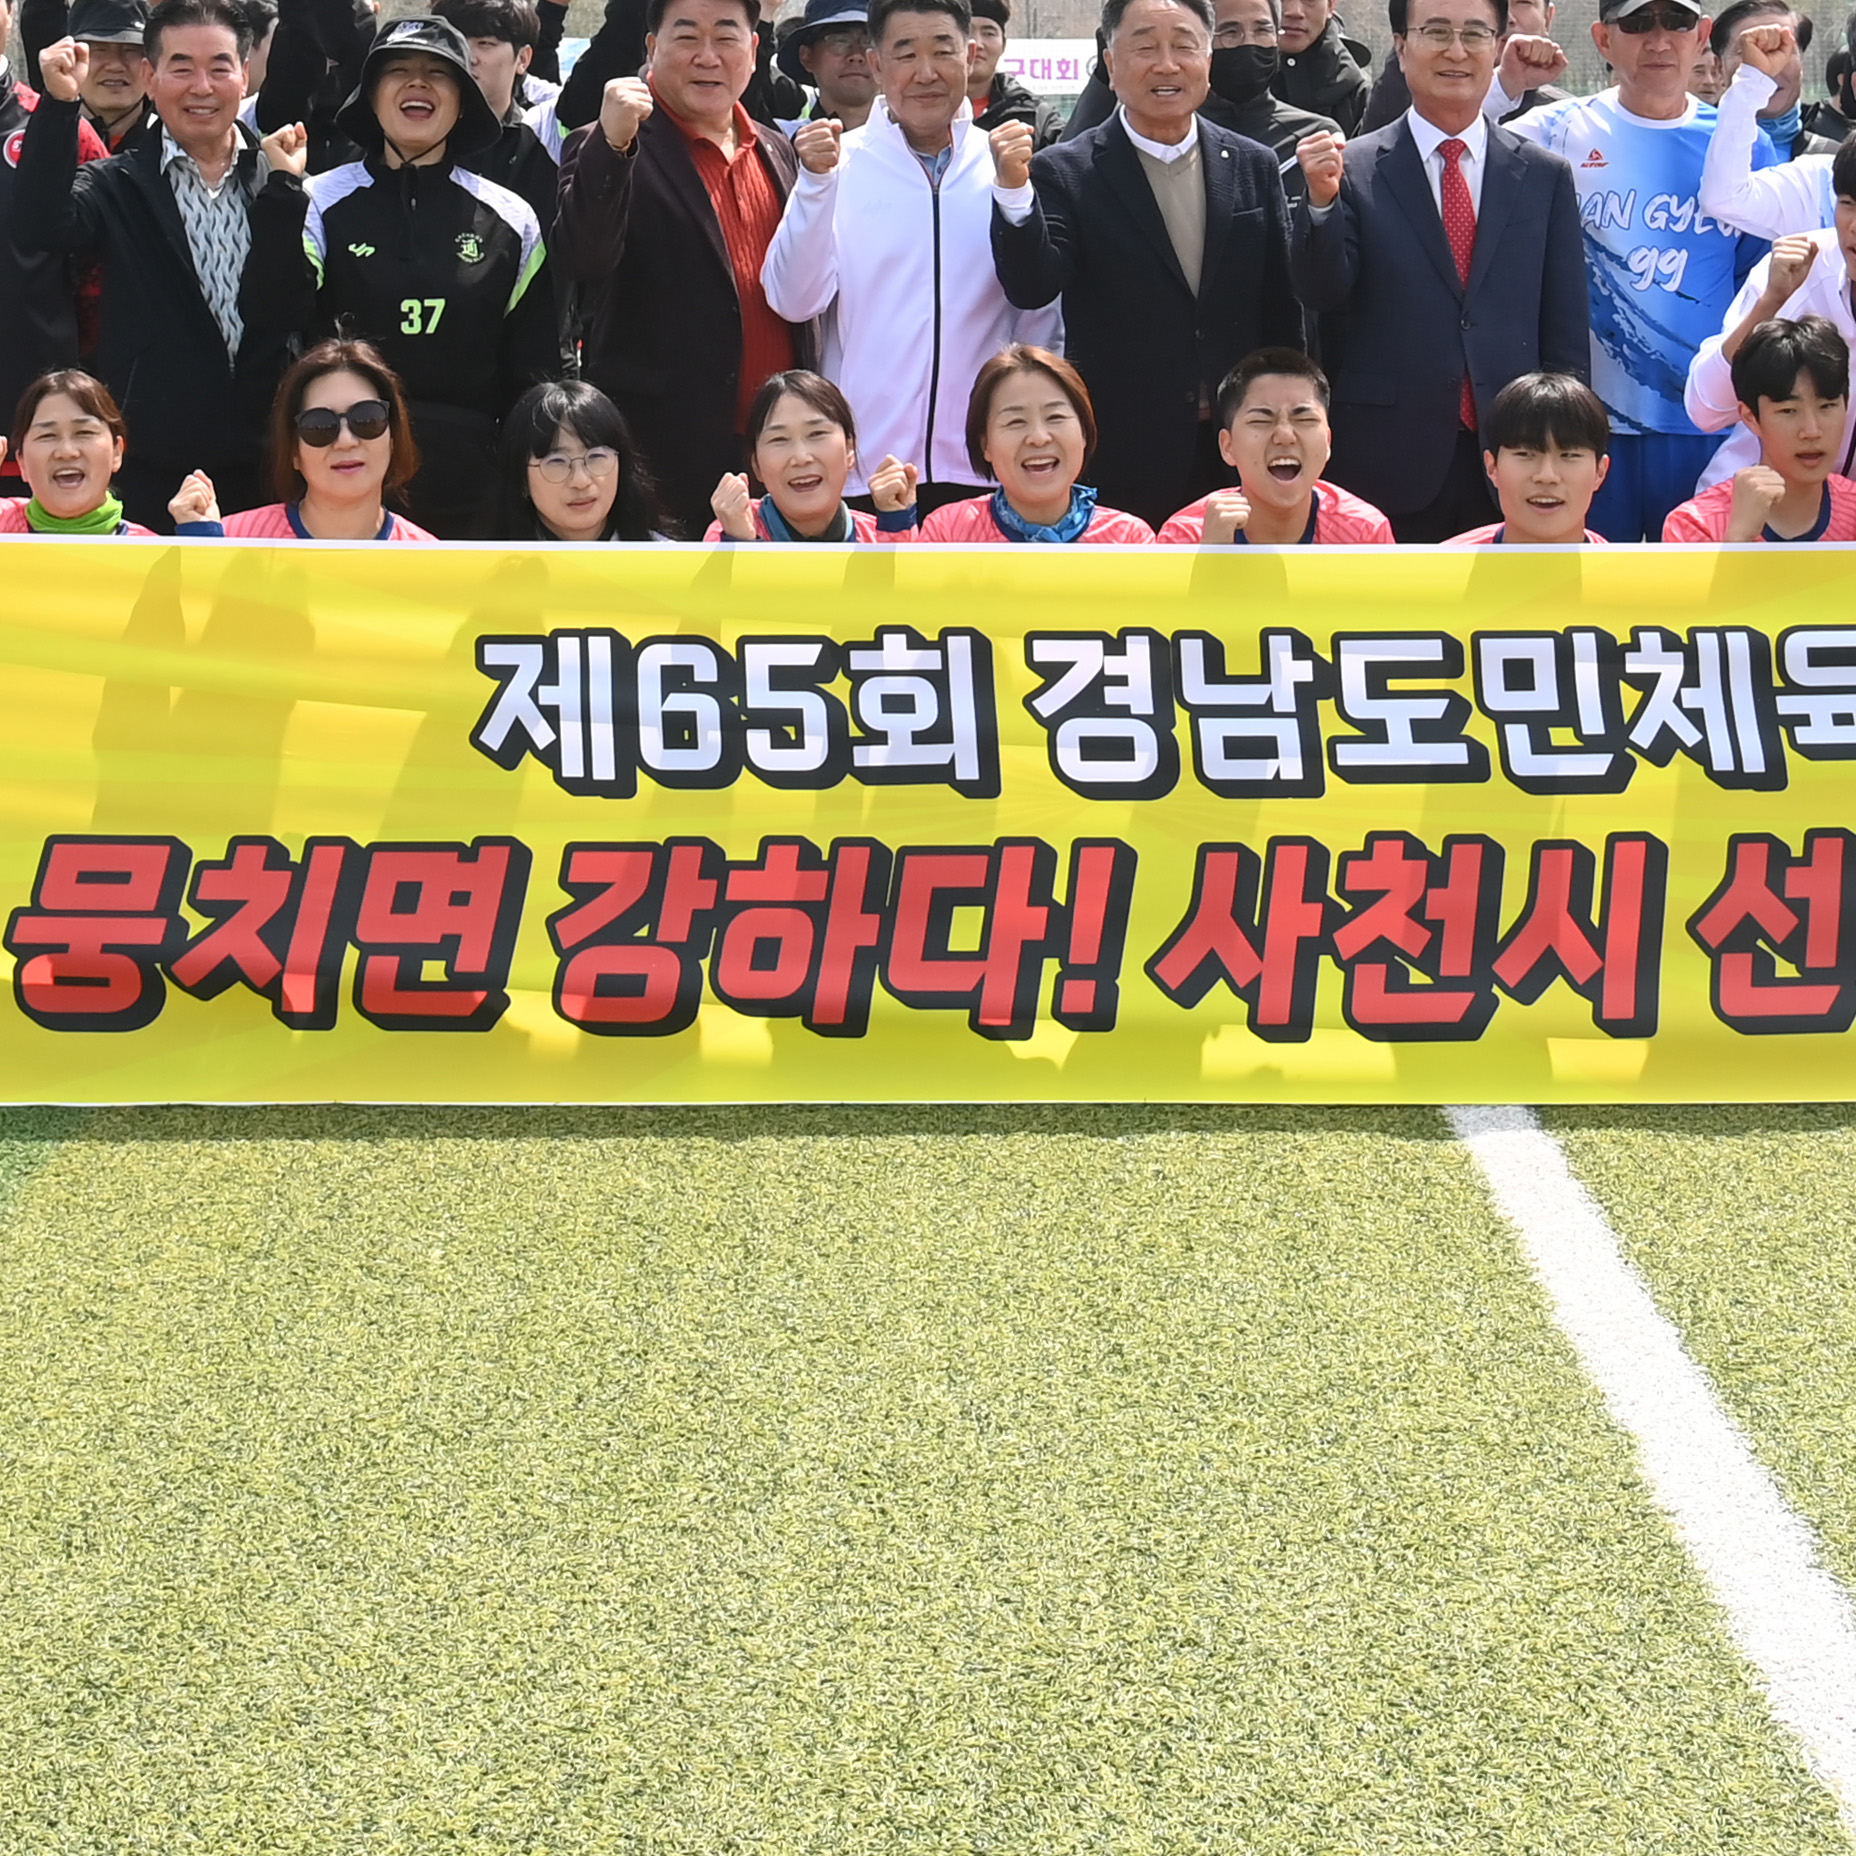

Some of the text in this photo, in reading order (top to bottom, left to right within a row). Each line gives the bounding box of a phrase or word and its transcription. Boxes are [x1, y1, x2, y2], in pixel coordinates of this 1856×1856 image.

[1576, 189, 1636, 230] AN
[1627, 246, 1689, 292] 99
[400, 299, 446, 335] 37
[470, 625, 1001, 798] 제65회
[3, 835, 532, 1033] 뭉치면
[546, 837, 1139, 1033] 강하다!
[1143, 832, 1668, 1042] 사천시
